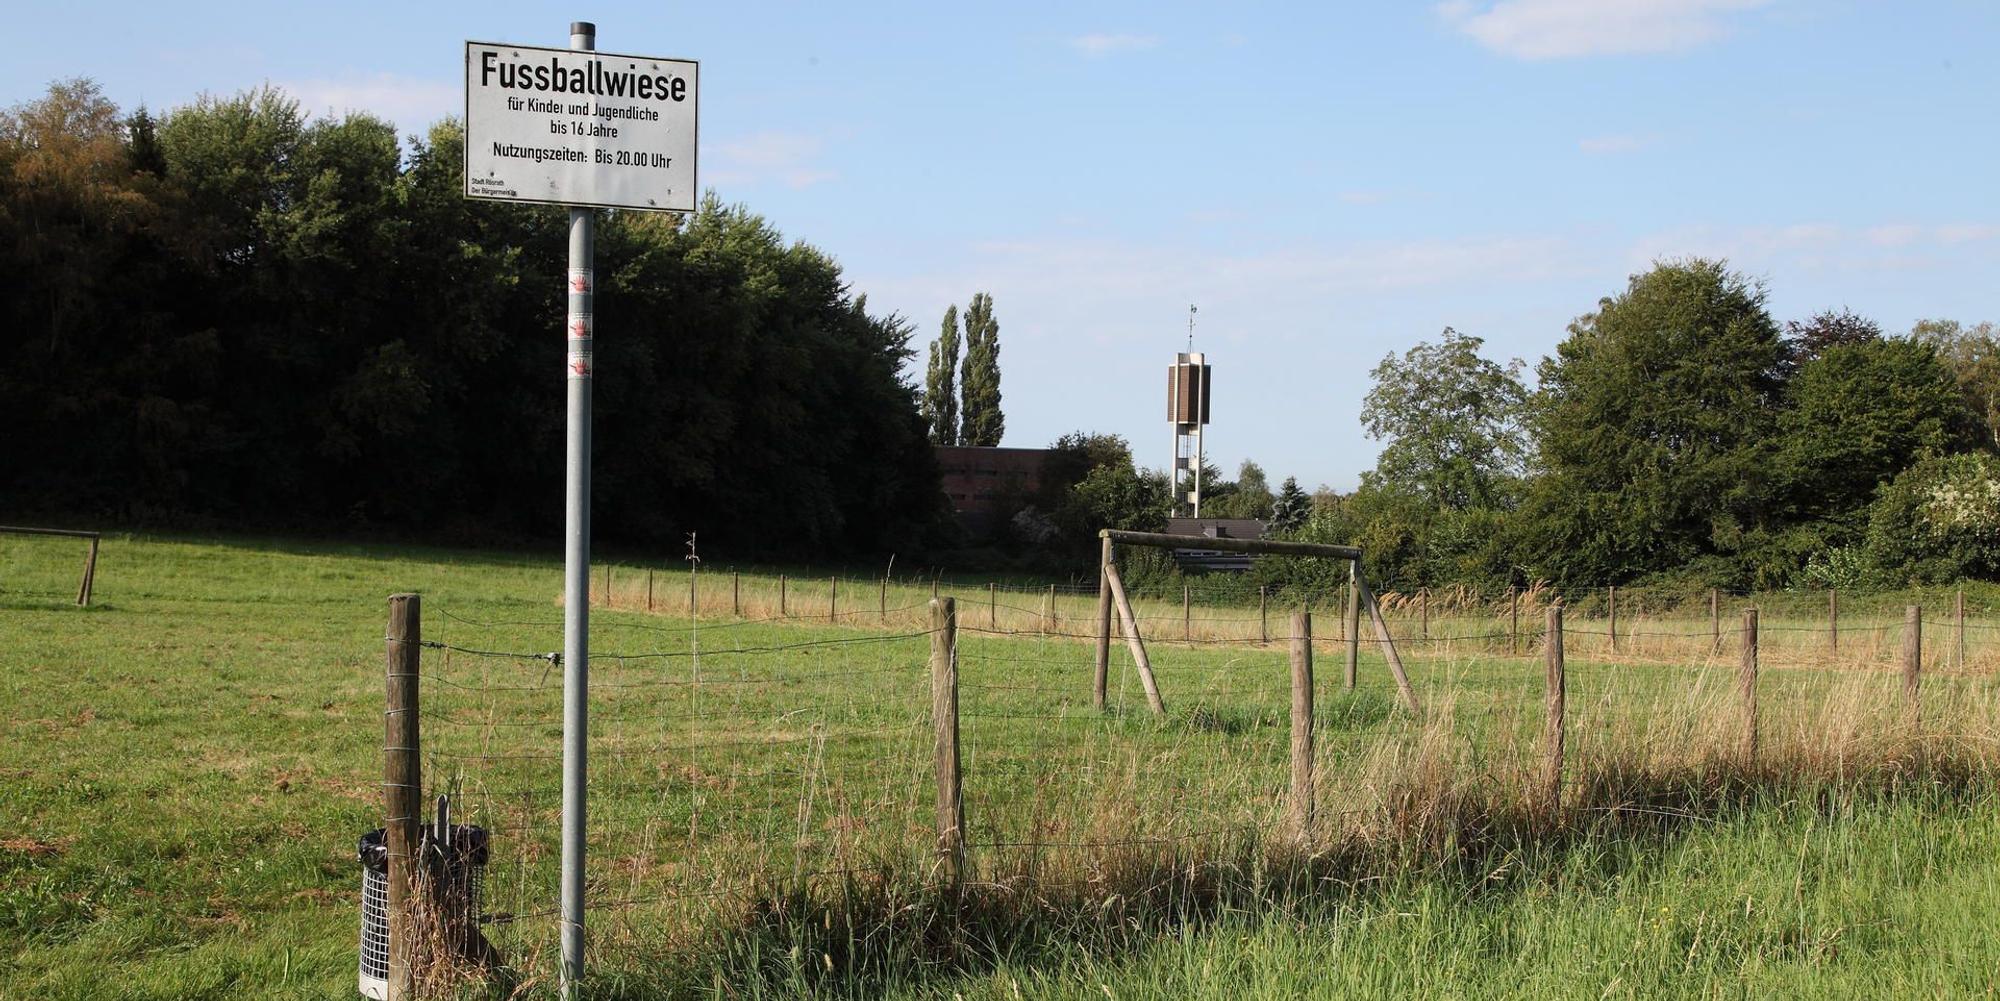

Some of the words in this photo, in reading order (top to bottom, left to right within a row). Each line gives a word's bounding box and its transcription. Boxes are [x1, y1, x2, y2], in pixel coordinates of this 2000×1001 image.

[481, 51, 686, 102] Fussballwiese
[508, 97, 525, 111] für
[528, 98, 563, 113] Kinder
[569, 103, 589, 116] und
[592, 104, 659, 121] Jugendliche
[550, 120, 567, 134] bis
[571, 122, 584, 135] 16
[587, 123, 618, 138] Jahre
[493, 142, 588, 163] Nutzungszeiten:
[595, 149, 613, 164] Bis
[617, 151, 648, 167] 20.00
[651, 154, 672, 169] Uhr
[482, 188, 517, 196] Bürgermeist
